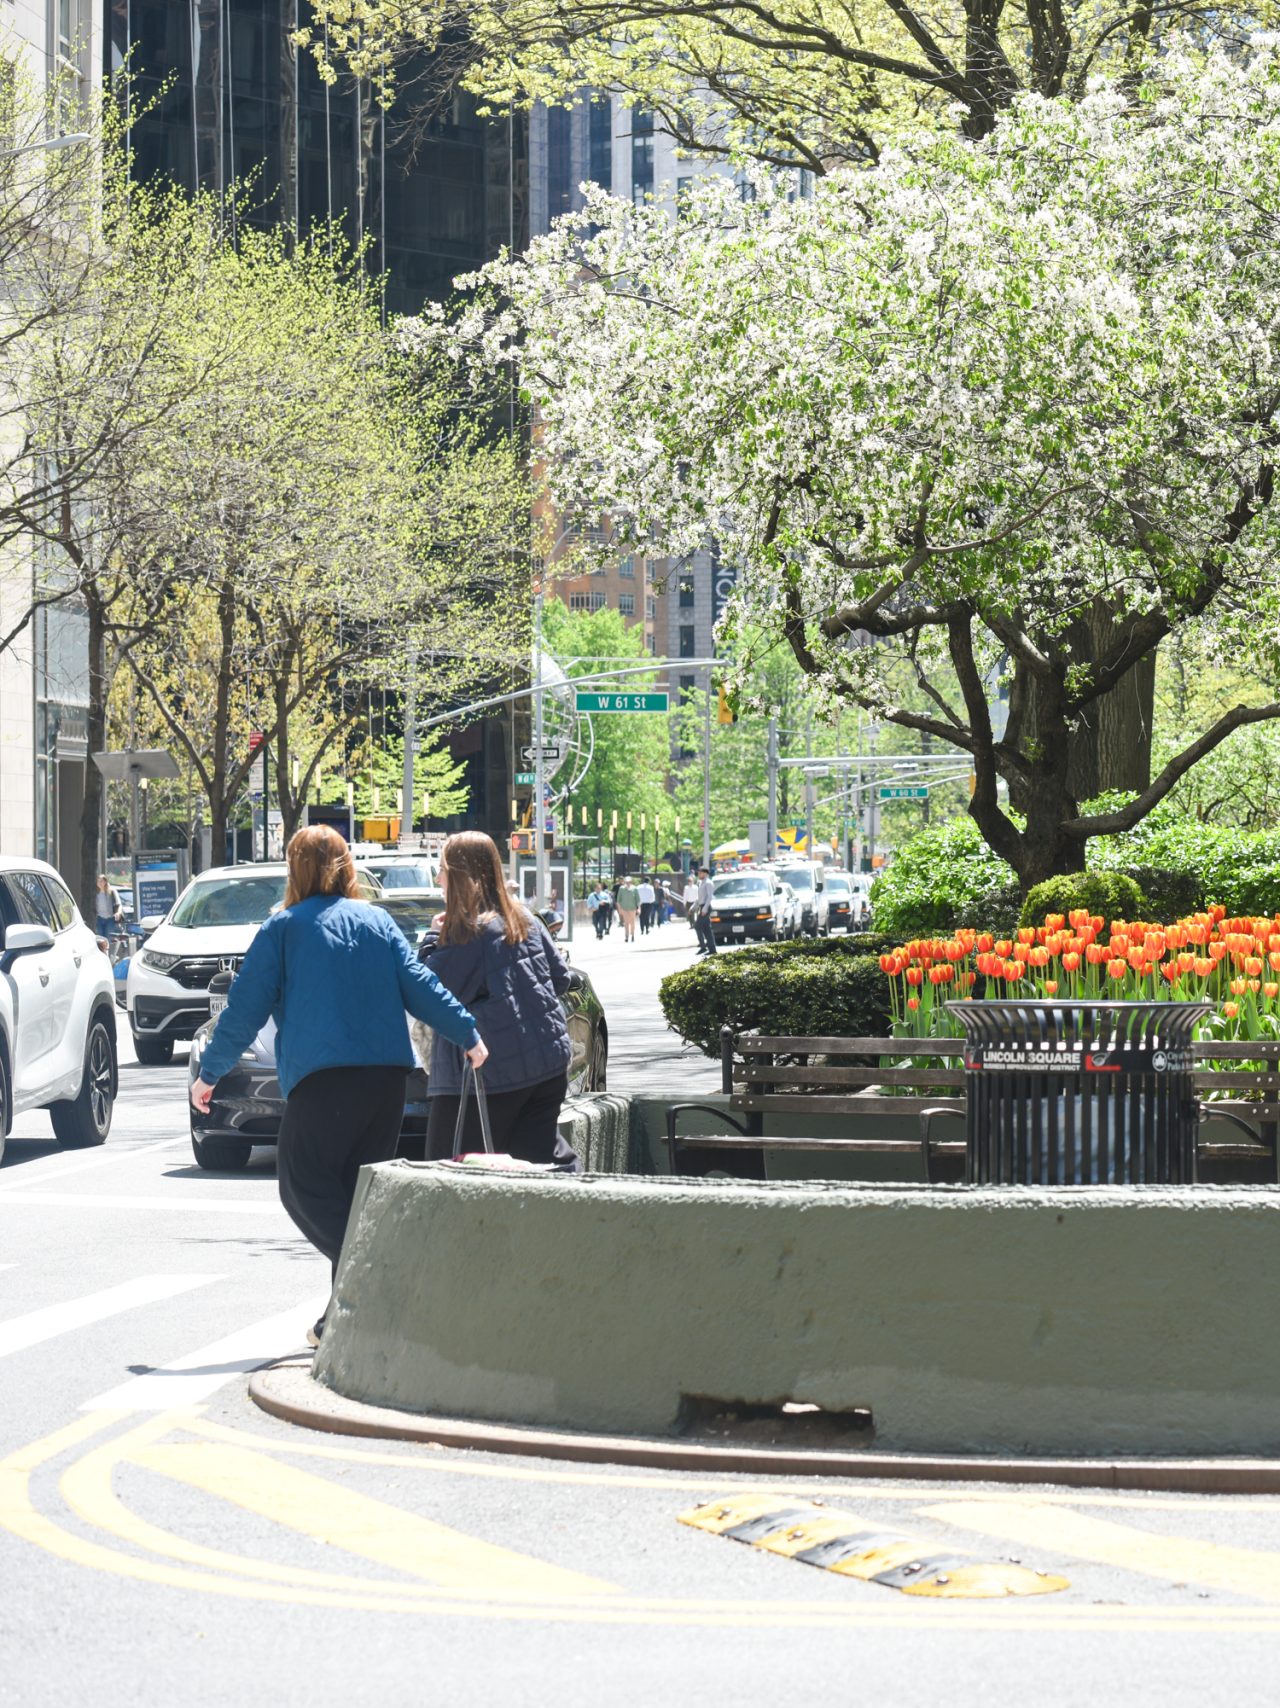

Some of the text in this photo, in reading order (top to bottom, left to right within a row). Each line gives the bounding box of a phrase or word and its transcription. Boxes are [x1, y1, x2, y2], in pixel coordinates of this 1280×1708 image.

[598, 696, 646, 709] W 61 St
[983, 1052, 1025, 1063] LINCOLN
[1027, 1052, 1080, 1064] SQUARE
